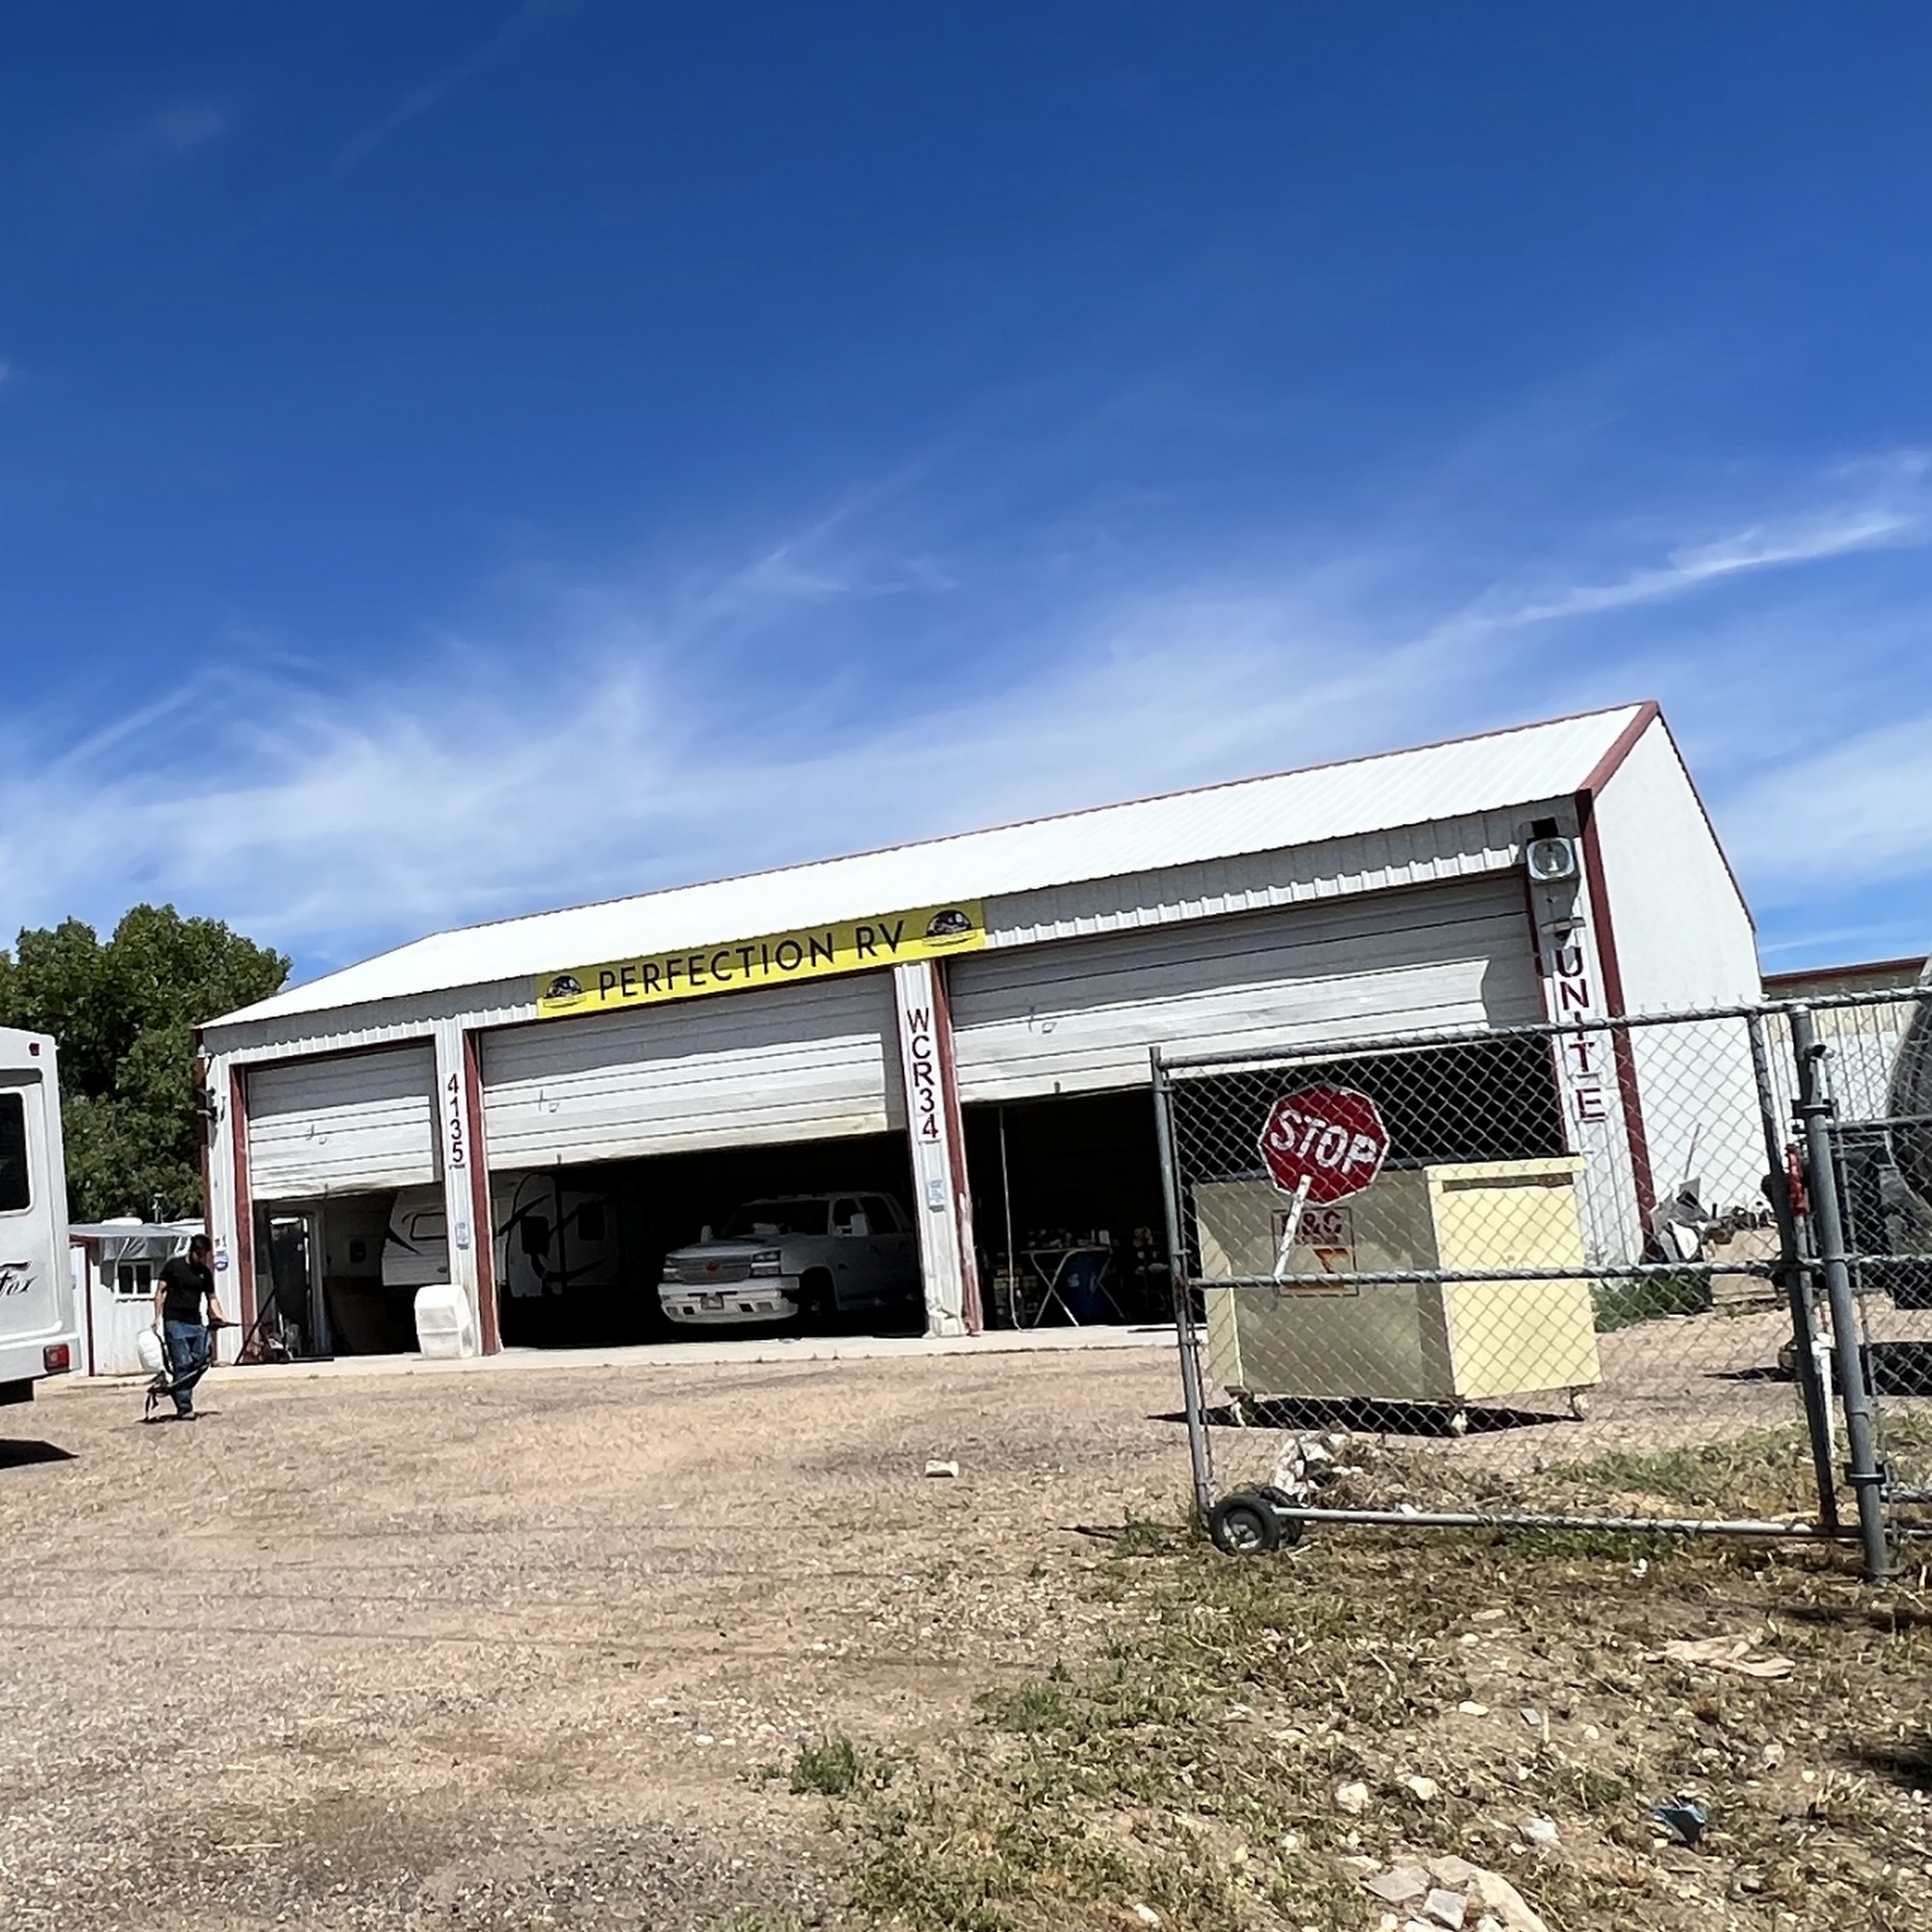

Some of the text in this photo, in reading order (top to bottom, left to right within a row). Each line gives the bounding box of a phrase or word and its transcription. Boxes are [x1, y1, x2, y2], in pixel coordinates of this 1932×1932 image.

[599, 920, 904, 1001] PERFECTION RV
[447, 1073, 464, 1163] 4135
[1270, 1109, 1378, 1175] STOP
